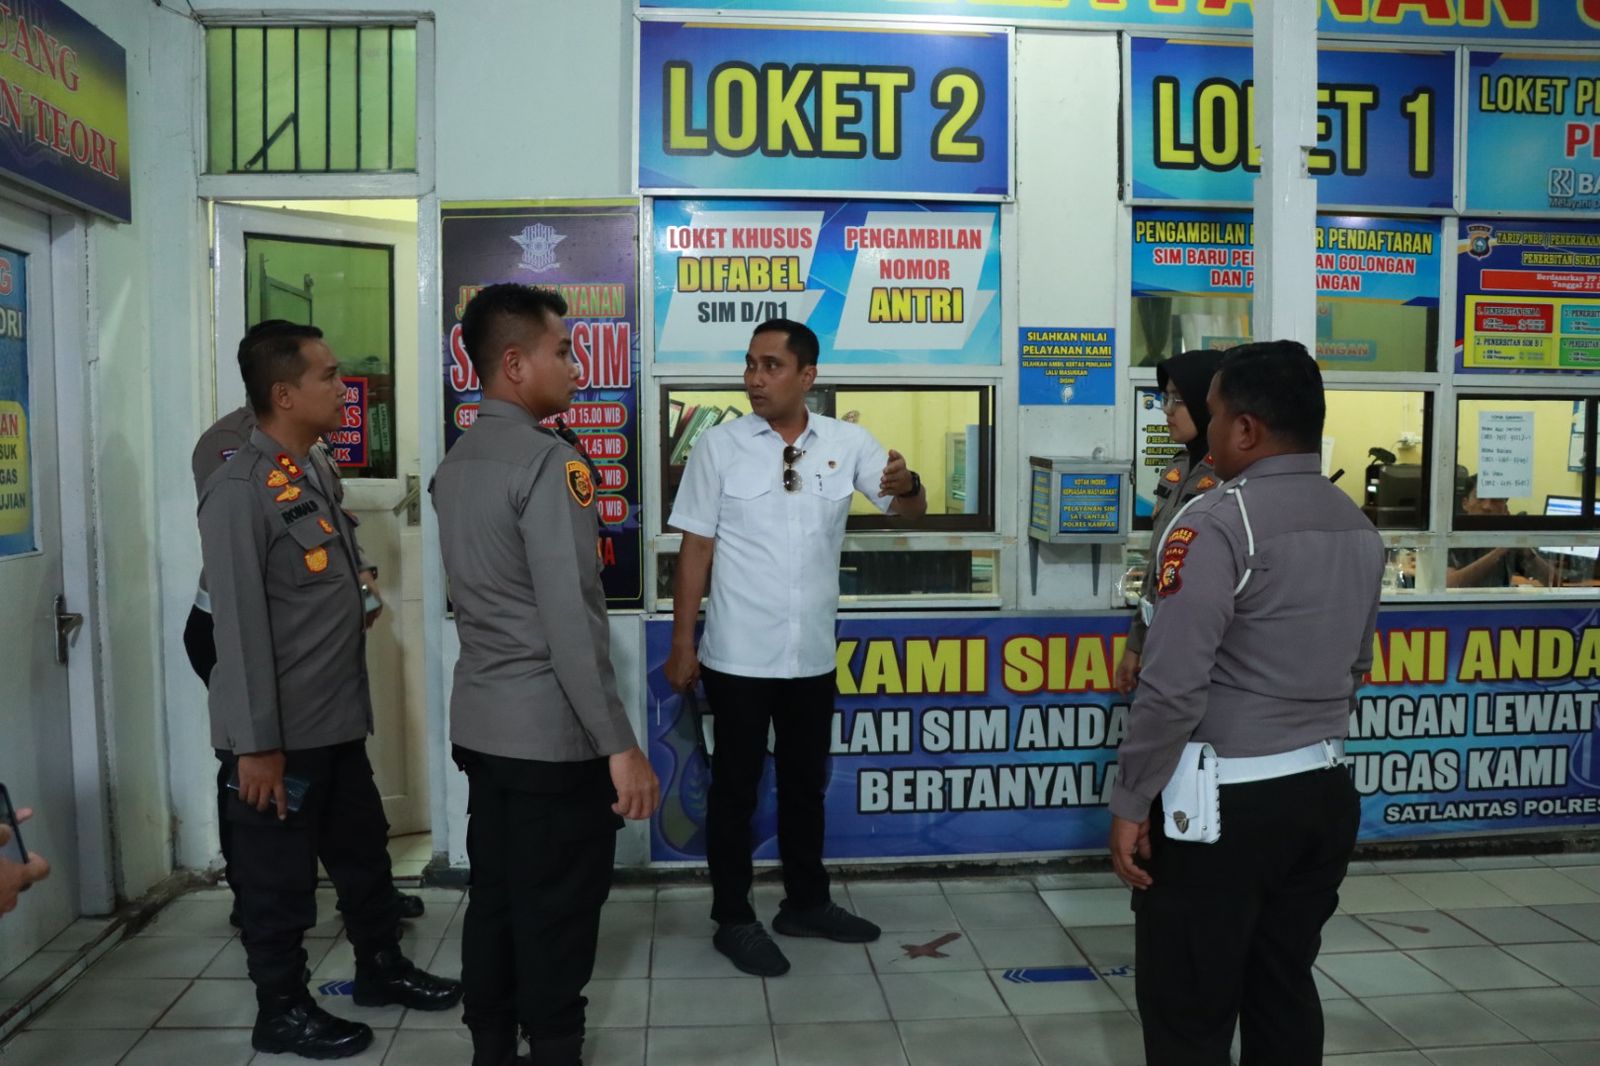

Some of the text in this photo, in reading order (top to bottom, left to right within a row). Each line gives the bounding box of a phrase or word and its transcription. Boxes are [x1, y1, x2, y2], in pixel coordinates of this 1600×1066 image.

[1480, 75, 1570, 115] LOKET
[666, 62, 983, 160] LOKET 2
[30, 94, 119, 180] TEORI
[1403, 90, 1432, 176] 1
[668, 227, 814, 249] LOKET KHUSUS
[845, 227, 983, 250] PENGAMBILAN
[1135, 220, 1245, 245] PENGAMBILAN
[1328, 227, 1433, 254] PENDAFTARAN
[879, 258, 951, 281] NOMOR
[1153, 248, 1182, 265] SIM
[1186, 249, 1227, 266] BARU
[1338, 254, 1416, 274] GOLONGAN
[677, 256, 806, 293] DIFABEL
[1211, 269, 1242, 287] DAN
[697, 301, 736, 323] SIM
[868, 287, 964, 324] ANTRI
[1027, 331, 1107, 342] SILAHKAN NILAI
[572, 323, 630, 388] SIM
[1022, 345, 1112, 355] PELAYANAN KAMI
[578, 408, 602, 424] 15.00
[604, 408, 621, 423] WIB
[604, 439, 622, 454] WIB
[605, 469, 622, 485] WIB
[605, 501, 623, 516] WIB
[1458, 628, 1600, 681] ANDA
[922, 707, 1008, 753] SIM
[1468, 747, 1568, 789] KAMI
[1386, 804, 1517, 822] SATLANTAS
